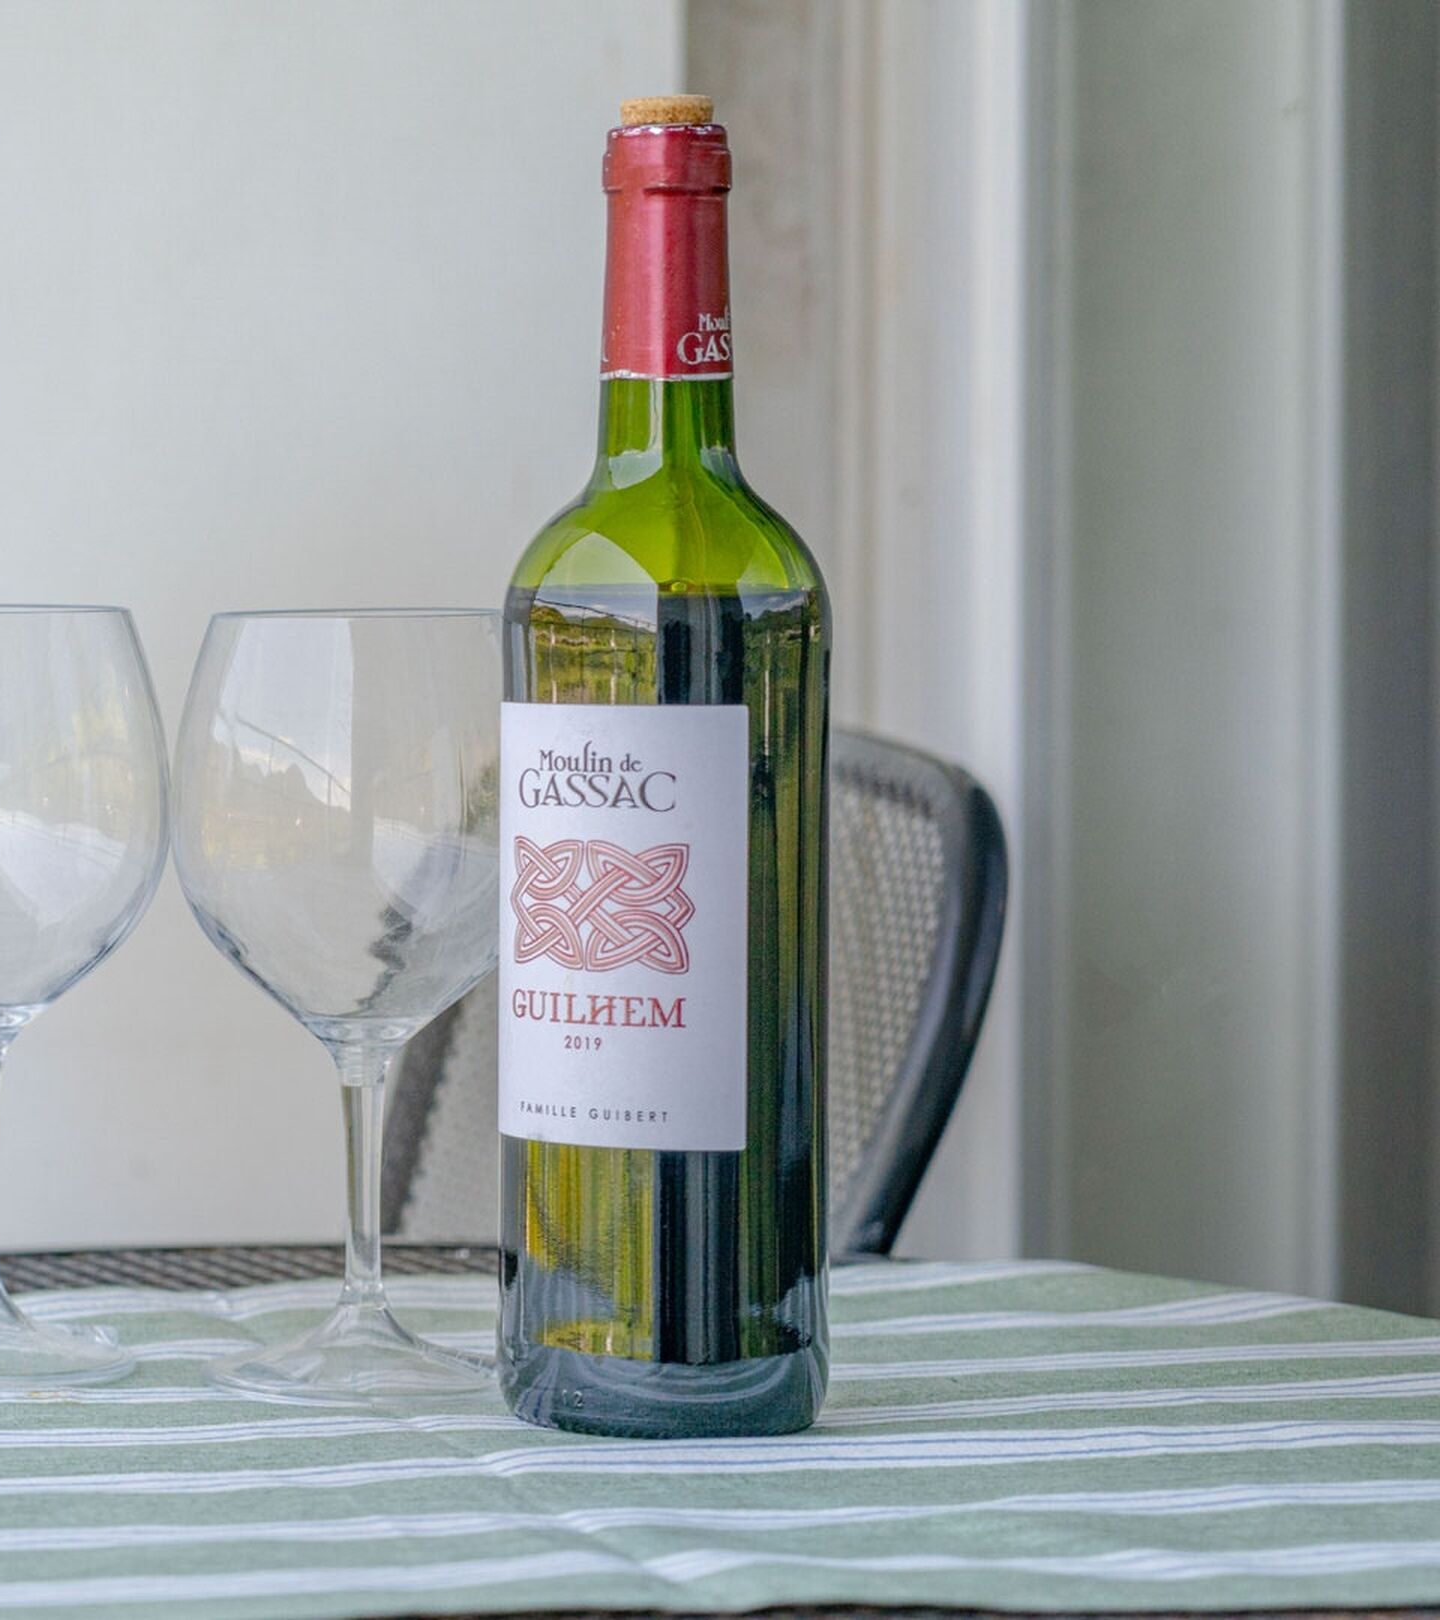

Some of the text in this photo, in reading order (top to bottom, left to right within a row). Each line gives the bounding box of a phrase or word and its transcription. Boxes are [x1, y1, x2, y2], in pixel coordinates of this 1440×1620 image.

[539, 740, 642, 773] Moulin de
[519, 768, 676, 812] GASSAC
[512, 989, 686, 1028] GUILHEM
[564, 1035, 602, 1050] 2019
[520, 1101, 668, 1122] FAMILLE GUIBERT
